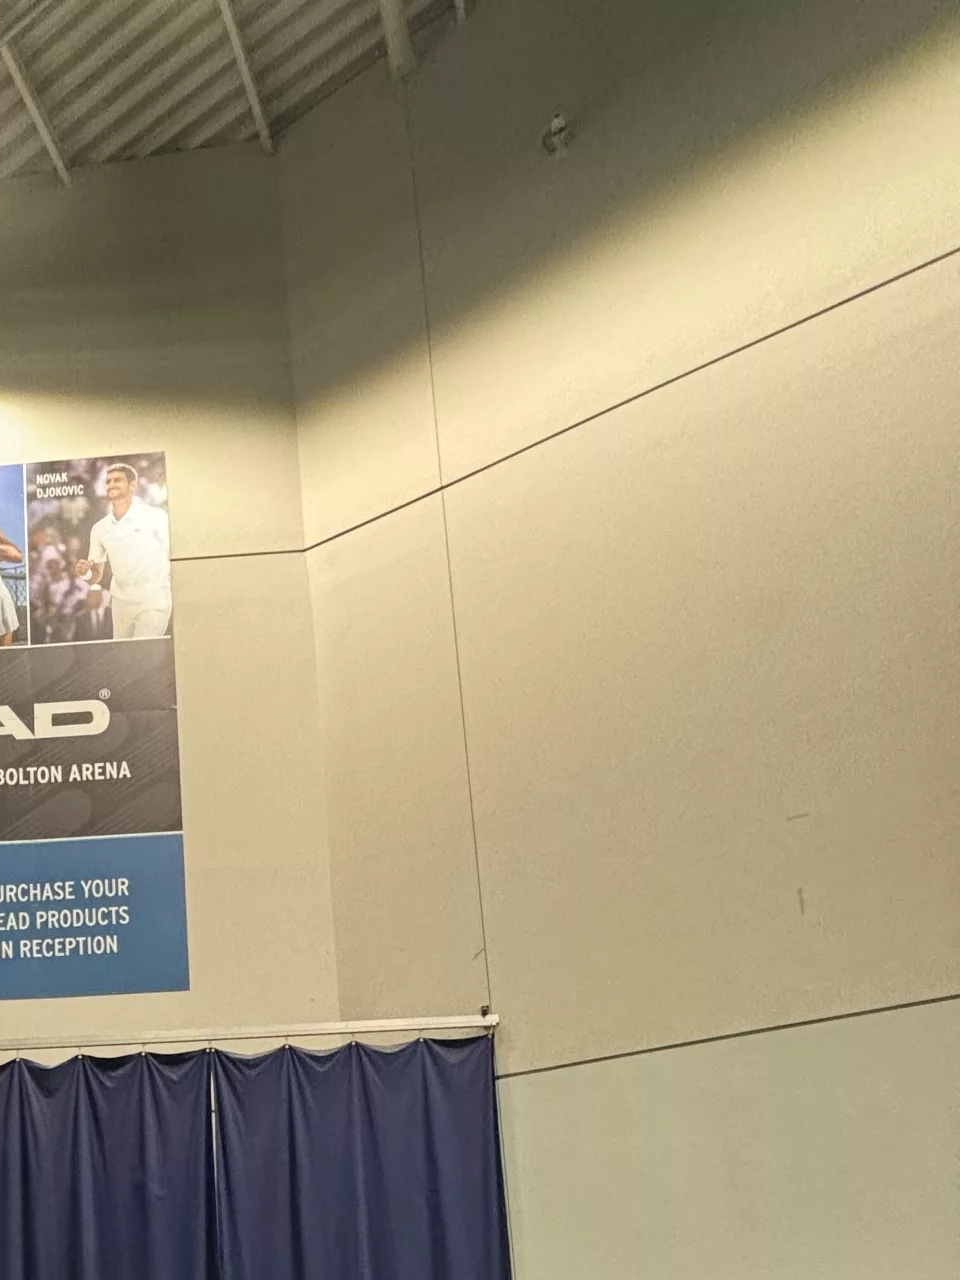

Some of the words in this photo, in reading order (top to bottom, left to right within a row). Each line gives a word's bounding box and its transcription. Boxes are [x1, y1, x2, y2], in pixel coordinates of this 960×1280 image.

[36, 471, 68, 485] NOVAK
[36, 484, 84, 499] DJOKOVIC
[69, 761, 132, 782] ARENA
[80, 877, 130, 899] YOUR
[35, 905, 130, 930] PRODUCTS
[19, 934, 119, 959] RECEPTION
